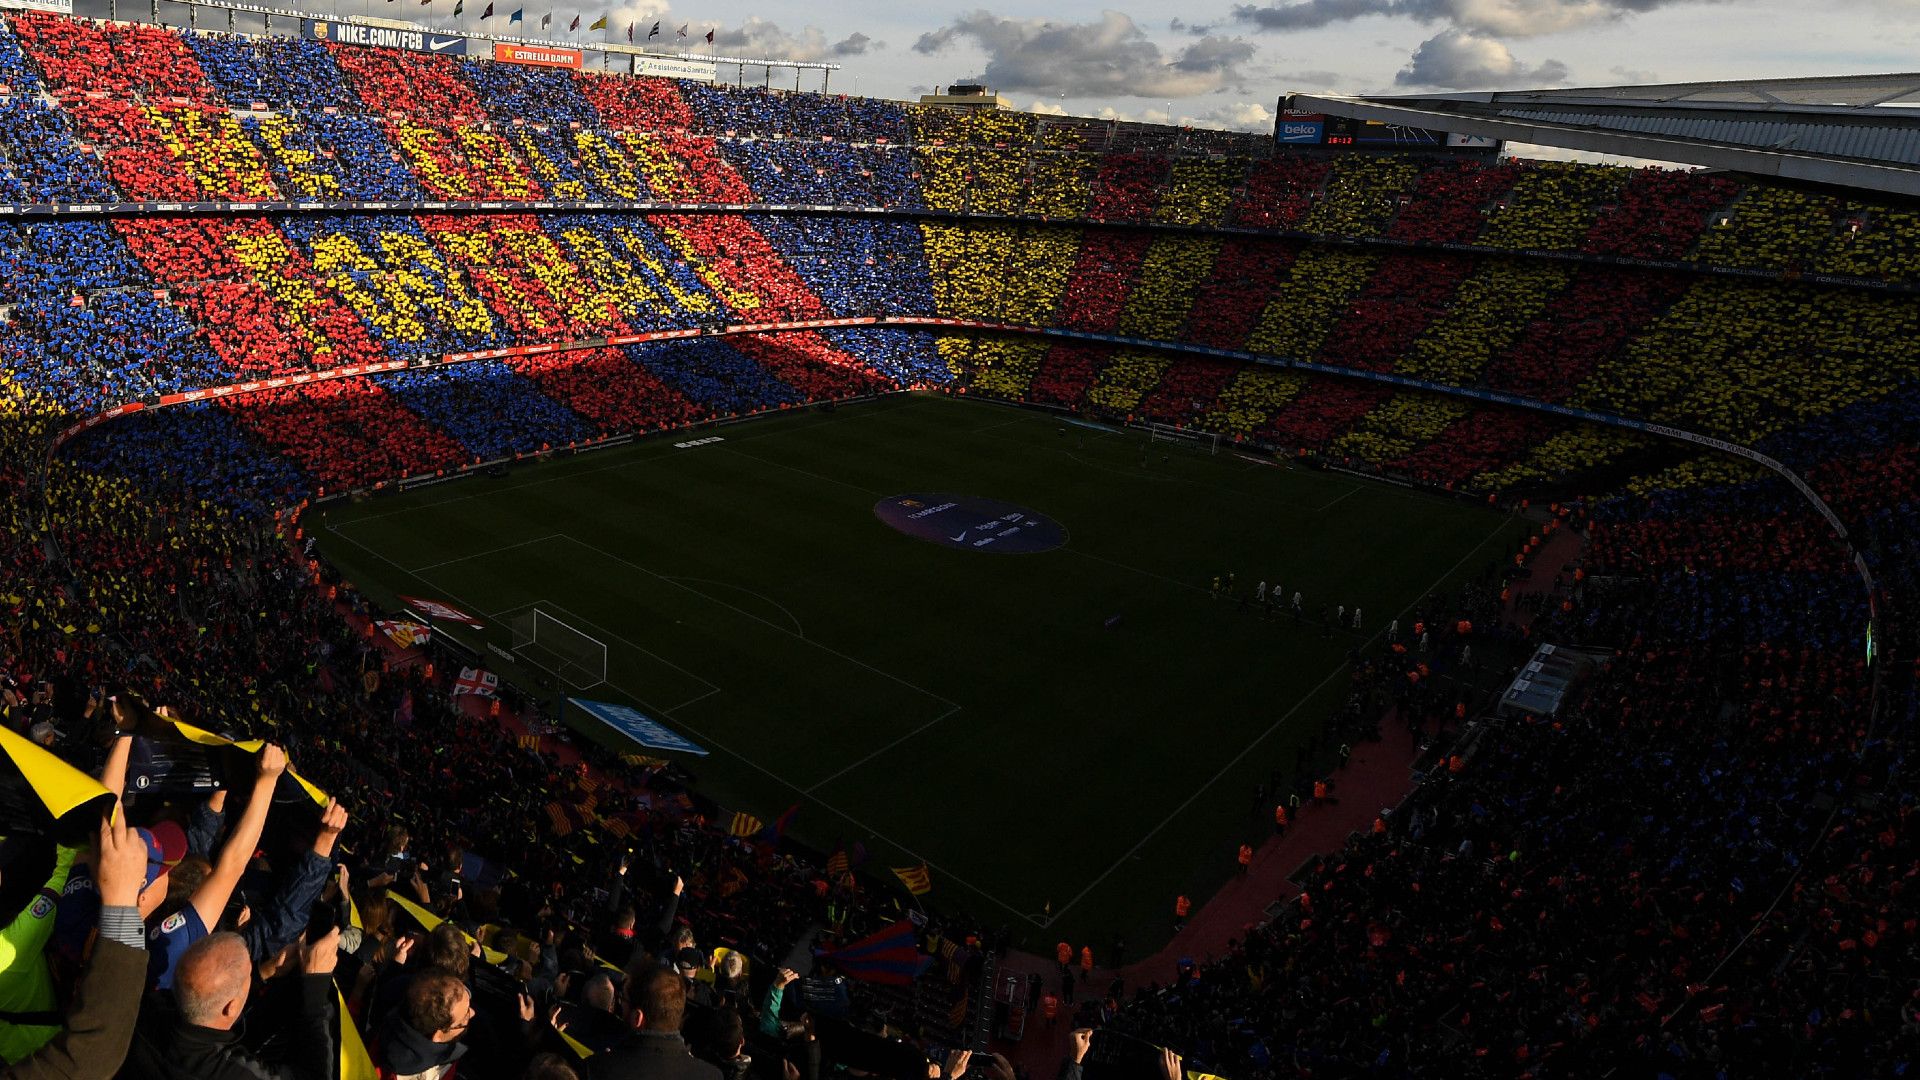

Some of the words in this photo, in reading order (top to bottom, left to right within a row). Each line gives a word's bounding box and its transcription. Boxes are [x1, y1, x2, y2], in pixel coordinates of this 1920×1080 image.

[337, 24, 423, 49] NIKE.COM/FCB
[514, 50, 550, 62] ESTRELLA
[551, 54, 574, 64] DAMM
[1284, 124, 1316, 134] beko
